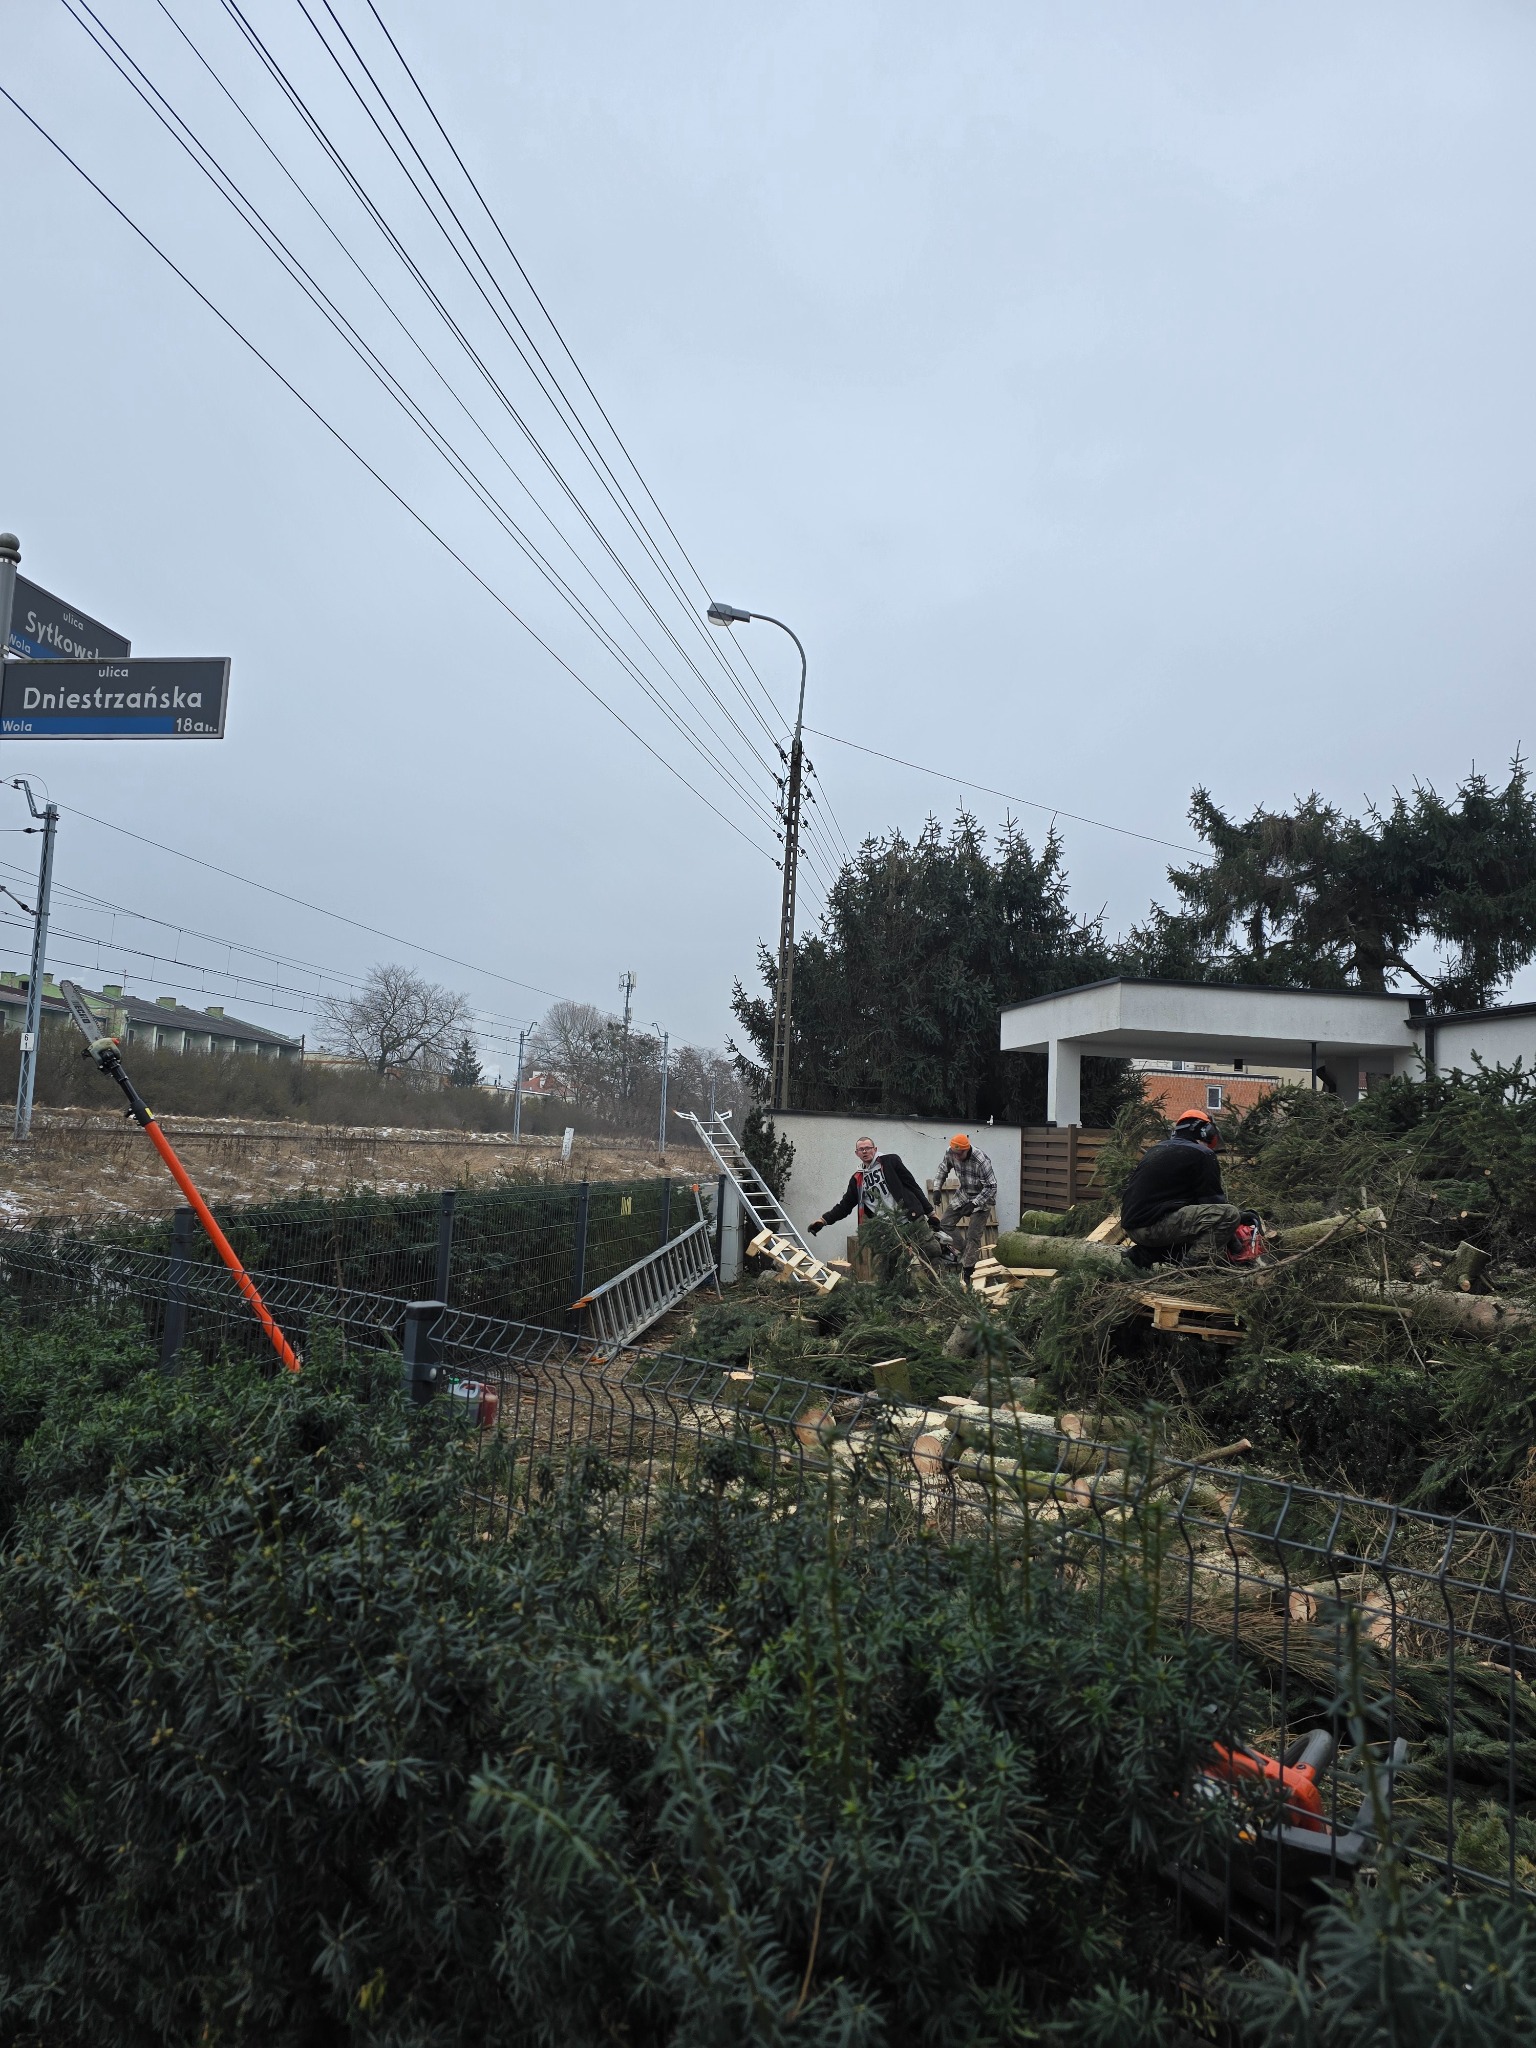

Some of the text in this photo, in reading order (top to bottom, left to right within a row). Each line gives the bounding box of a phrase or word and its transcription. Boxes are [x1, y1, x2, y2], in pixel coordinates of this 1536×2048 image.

[63, 612, 84, 630] ulica
[98, 666, 129, 677] ulica
[23, 686, 202, 710] Dniestrzańska
[2, 720, 33, 732] Wola
[864, 1169, 885, 1190] JUST
